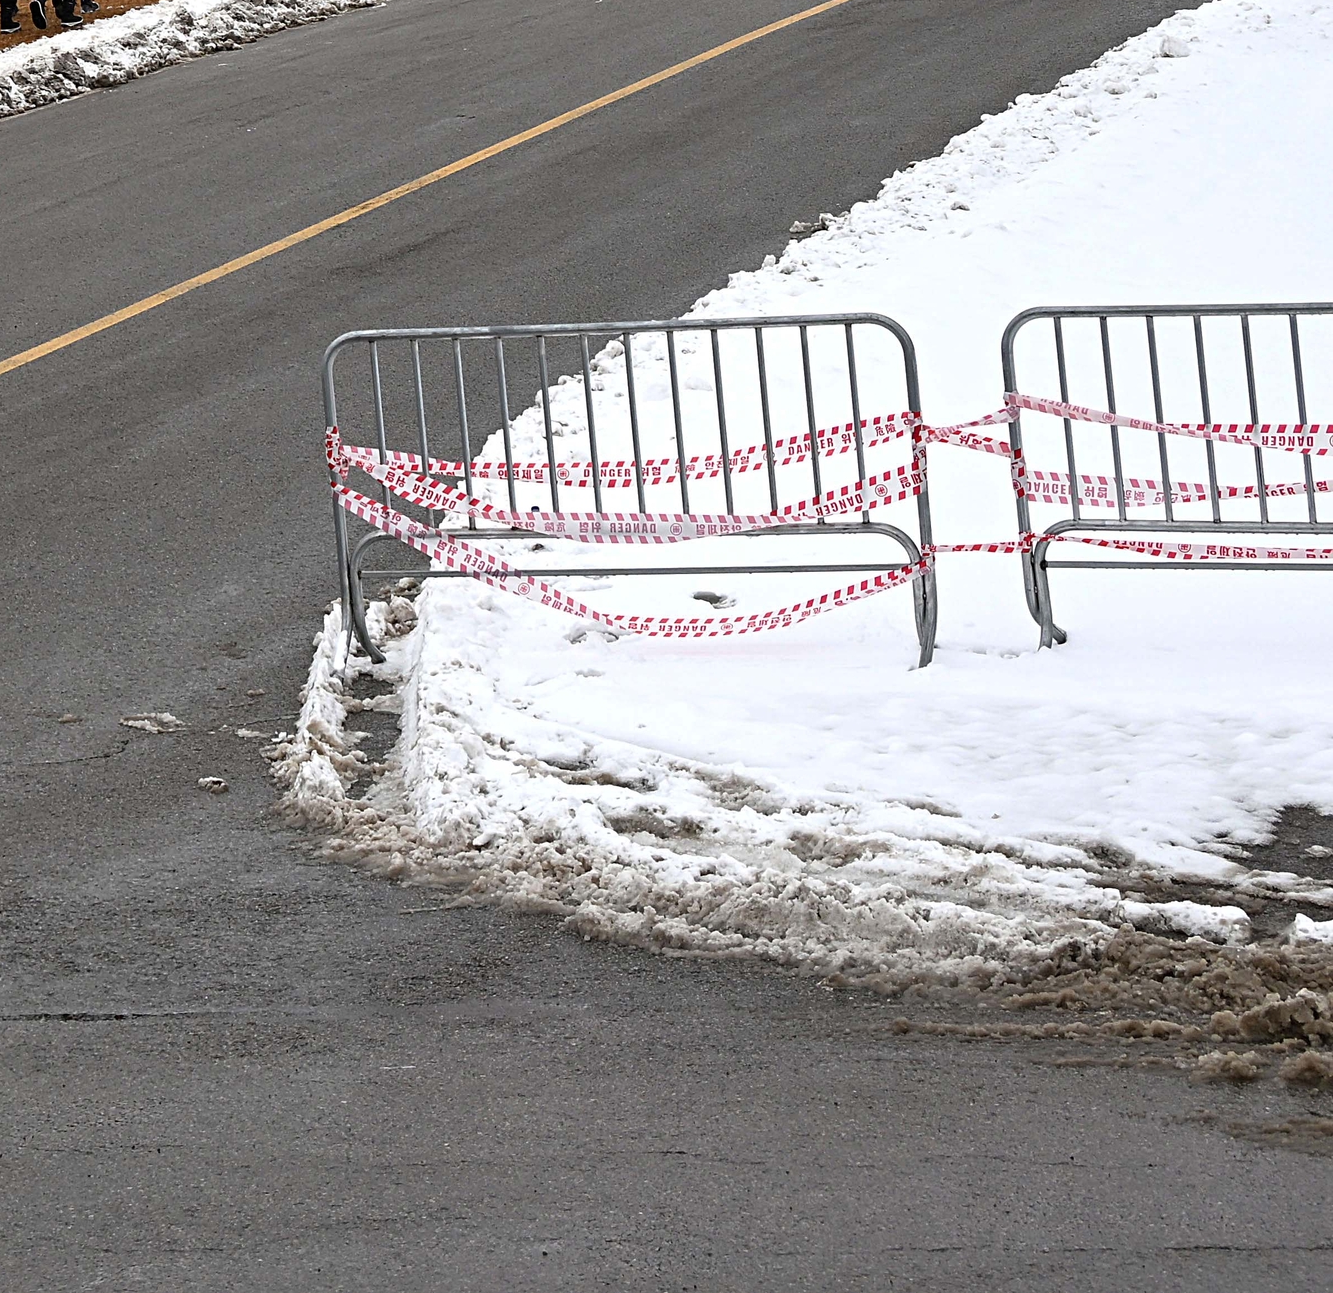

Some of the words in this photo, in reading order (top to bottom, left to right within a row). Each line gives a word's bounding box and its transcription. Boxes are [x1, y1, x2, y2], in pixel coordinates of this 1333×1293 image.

[1261, 435, 1314, 447] DANGER
[385, 471, 406, 488] 위험
[583, 468, 632, 478] DNGER
[412, 483, 457, 510] DANGER
[815, 493, 864, 516] DANGER
[658, 624, 707, 633] DANGER
